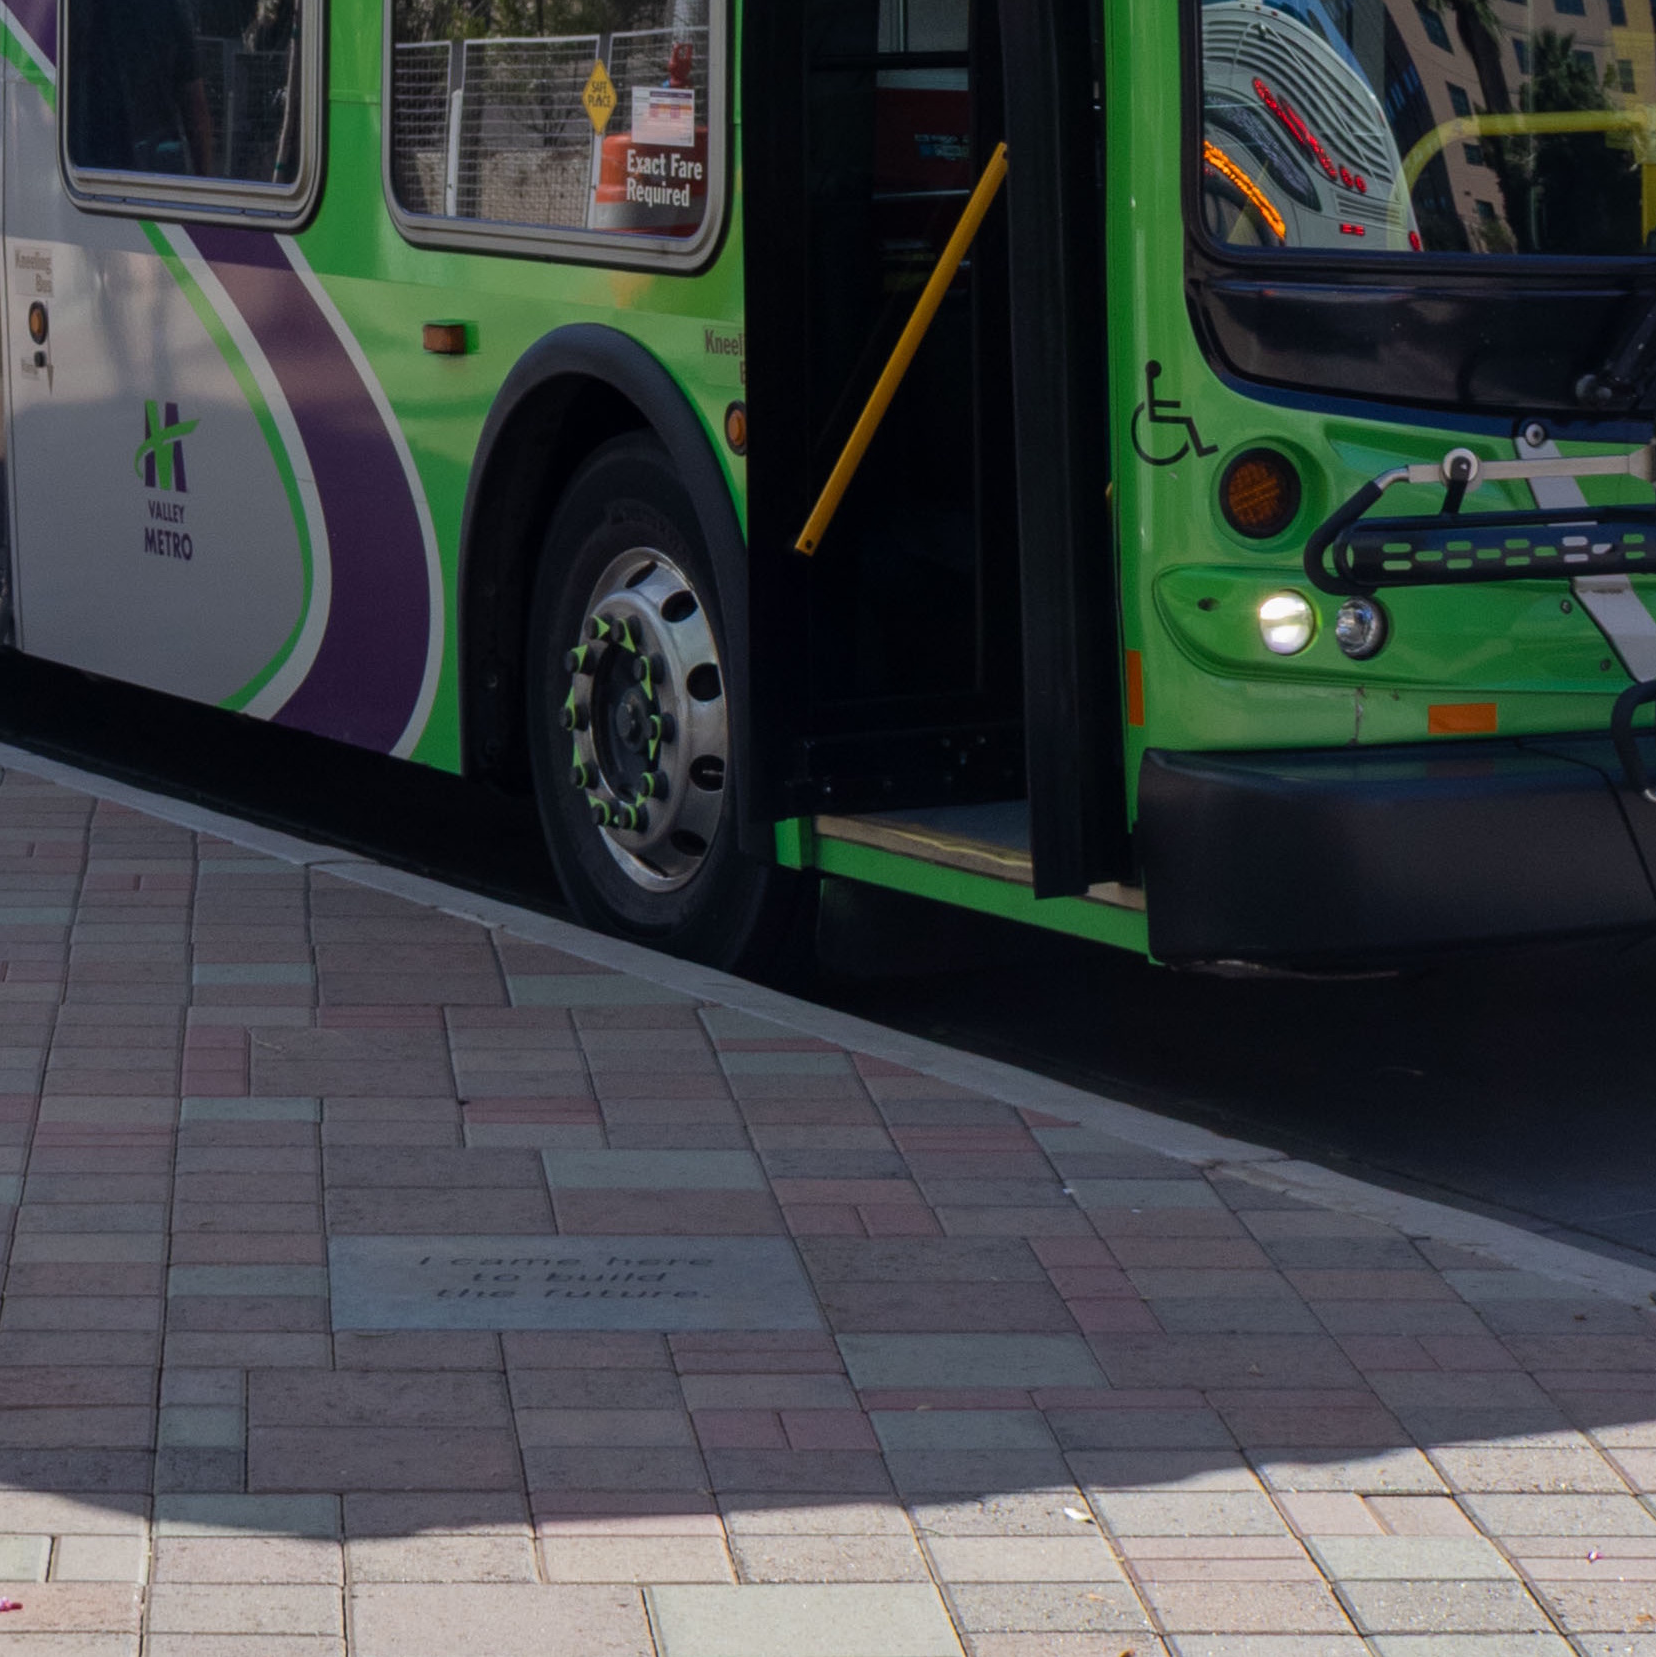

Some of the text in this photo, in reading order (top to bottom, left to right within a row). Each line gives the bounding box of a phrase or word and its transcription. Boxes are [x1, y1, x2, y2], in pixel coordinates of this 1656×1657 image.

[626, 149, 703, 180] Exact Fare
[626, 177, 691, 208] Required
[147, 499, 186, 524] VALLEY
[144, 527, 193, 561] METRO
[606, 1255, 714, 1266] here
[472, 1271, 667, 1282] to build
[436, 1288, 516, 1298] the
